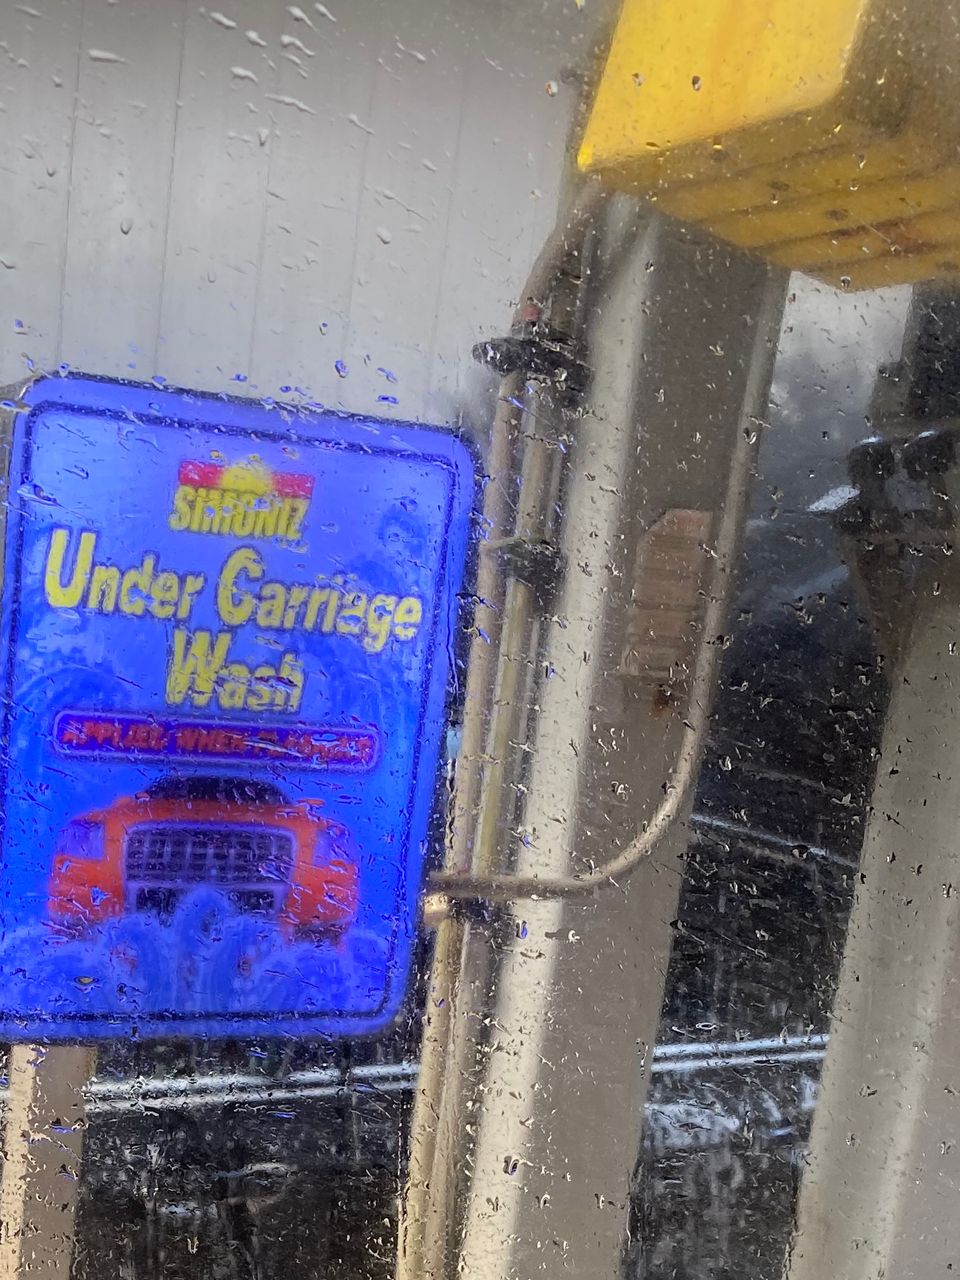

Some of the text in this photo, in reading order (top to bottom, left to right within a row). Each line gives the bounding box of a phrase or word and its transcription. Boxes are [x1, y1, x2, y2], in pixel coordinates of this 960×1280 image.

[43, 526, 423, 653] Under Carriage
[164, 628, 305, 713] Wash
